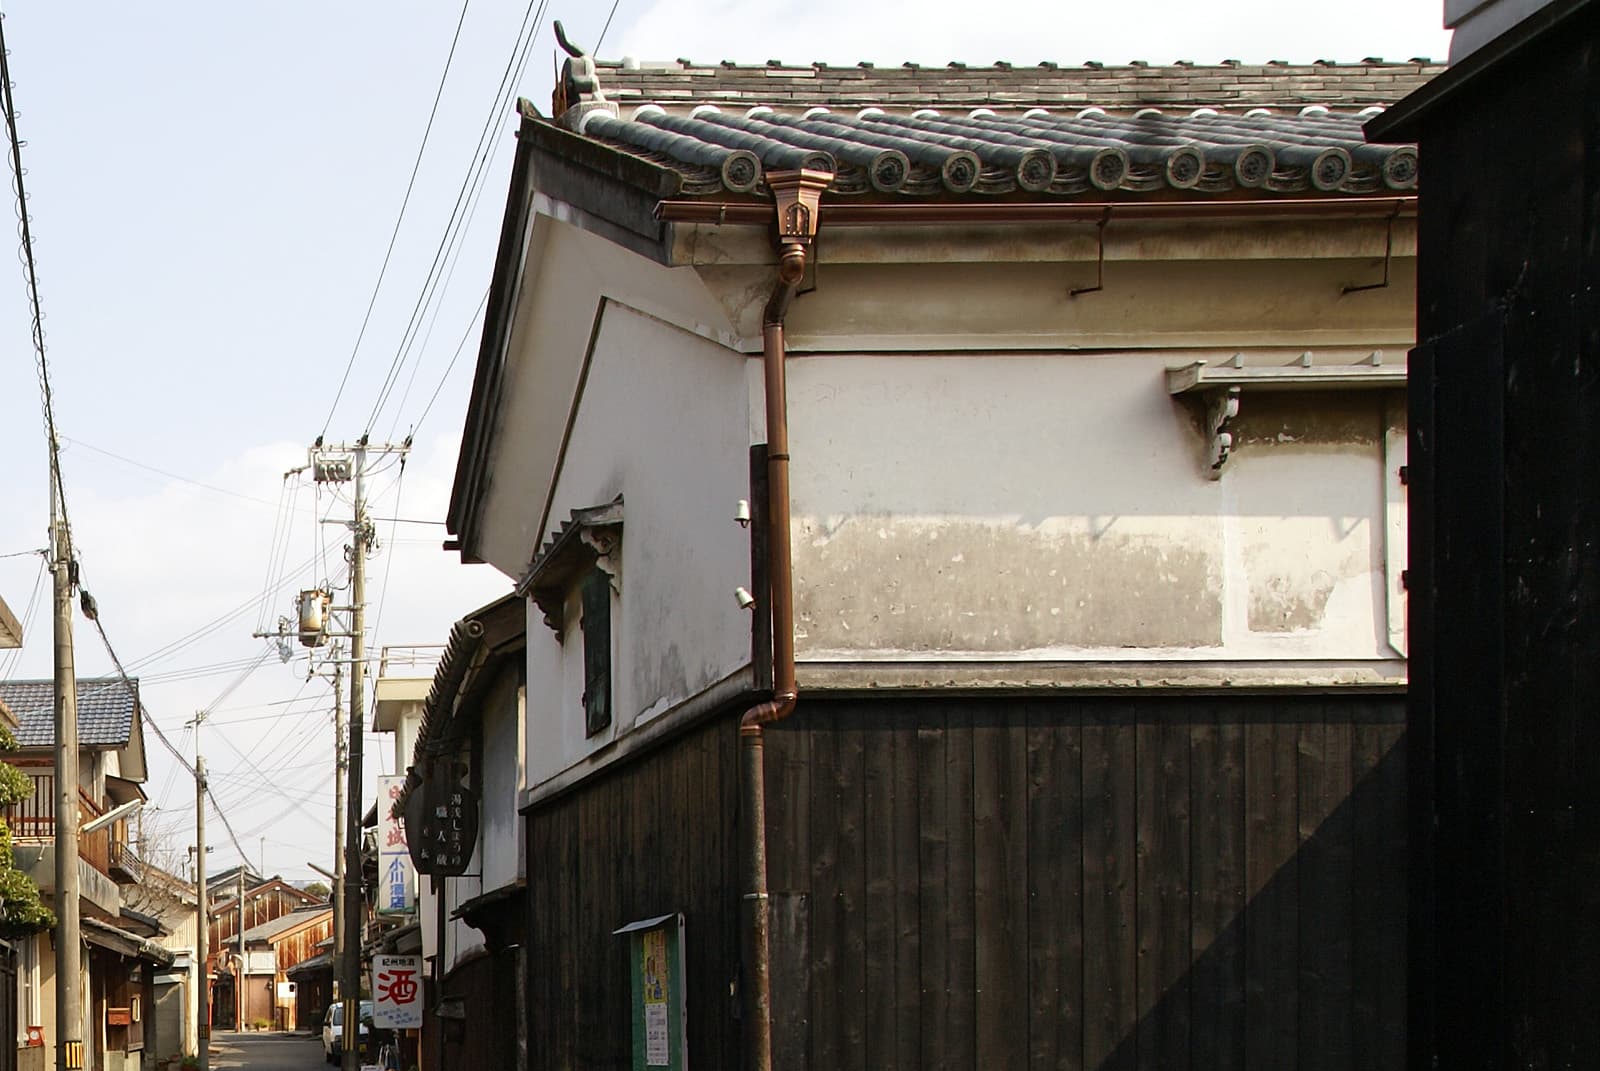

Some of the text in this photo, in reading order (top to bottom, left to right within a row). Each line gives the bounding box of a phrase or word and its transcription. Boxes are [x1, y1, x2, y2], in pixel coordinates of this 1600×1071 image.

[389, 857, 406, 909] 小川酒店
[377, 969, 418, 1005] 酒
